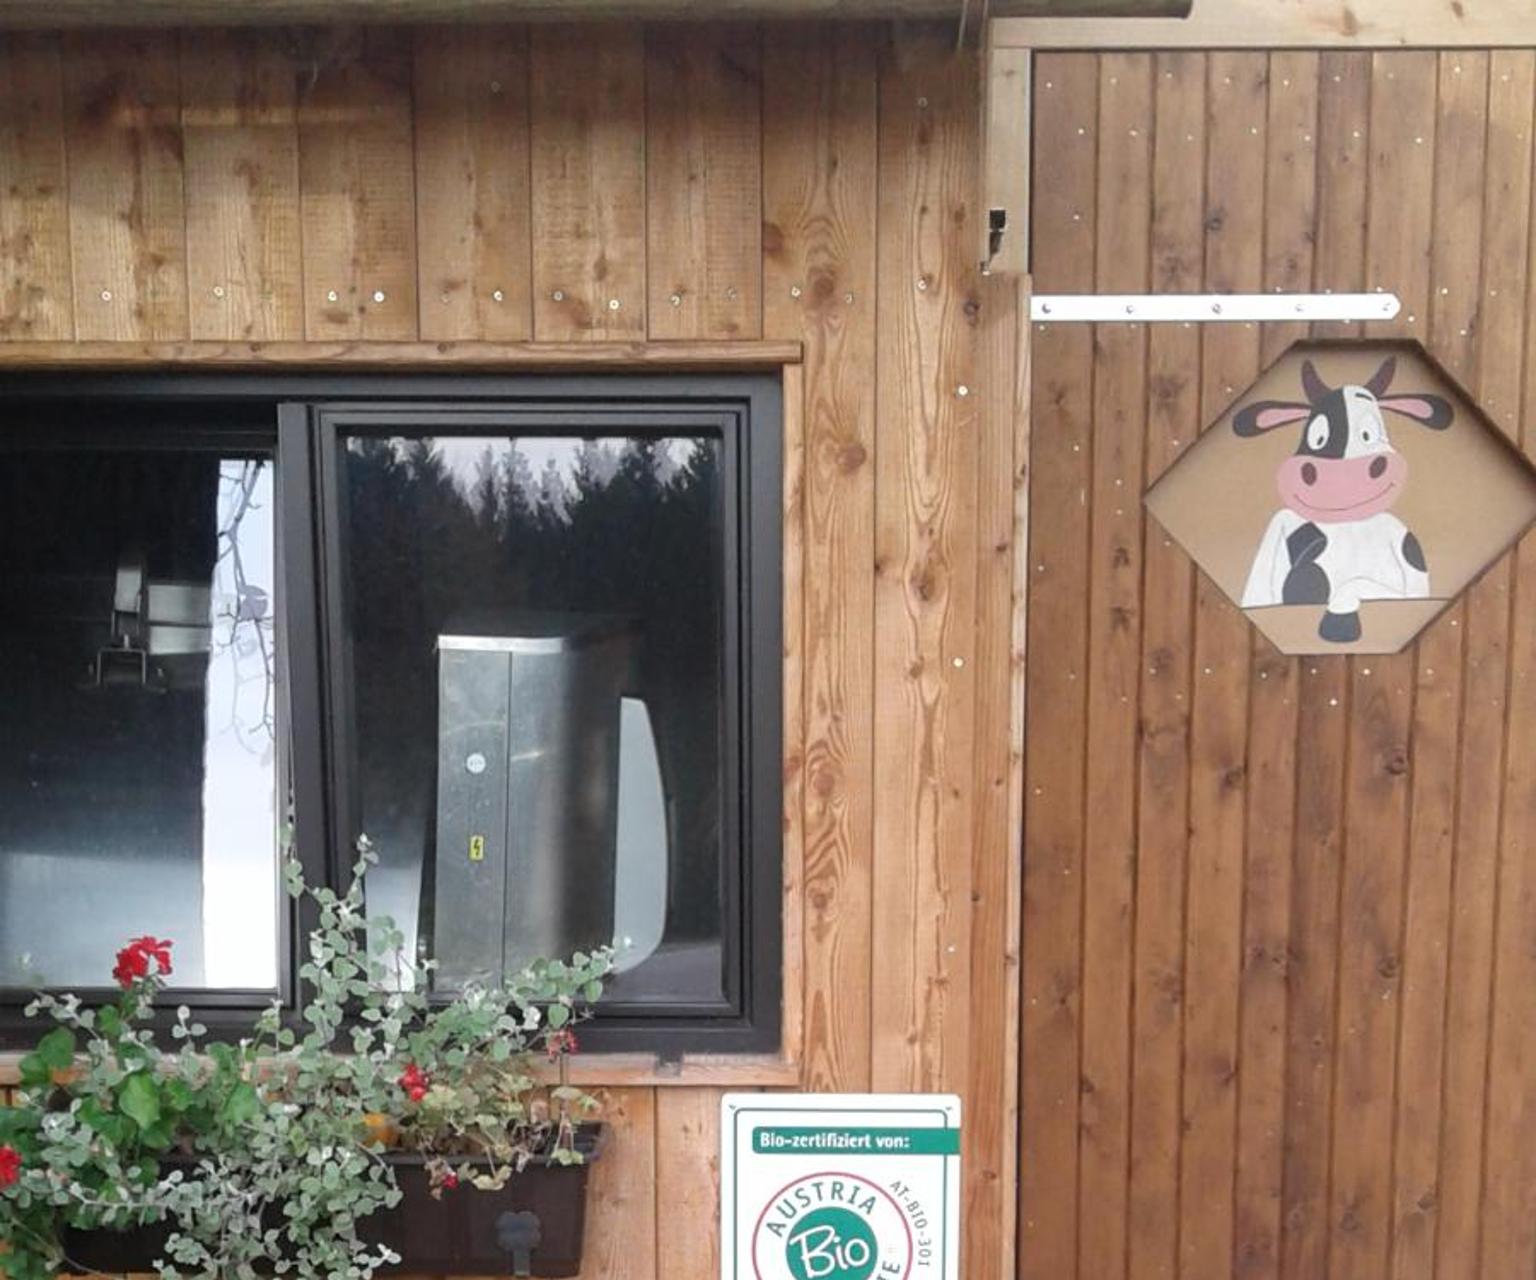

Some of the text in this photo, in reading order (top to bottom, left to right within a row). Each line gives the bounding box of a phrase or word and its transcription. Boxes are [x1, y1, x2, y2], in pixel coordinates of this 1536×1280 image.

[760, 1132, 910, 1148] Bio-zertifiziert von:
[767, 1181, 877, 1237] AUSTRIA
[889, 1180, 932, 1266] AT-BIO-301
[789, 1225, 870, 1279] Bio
